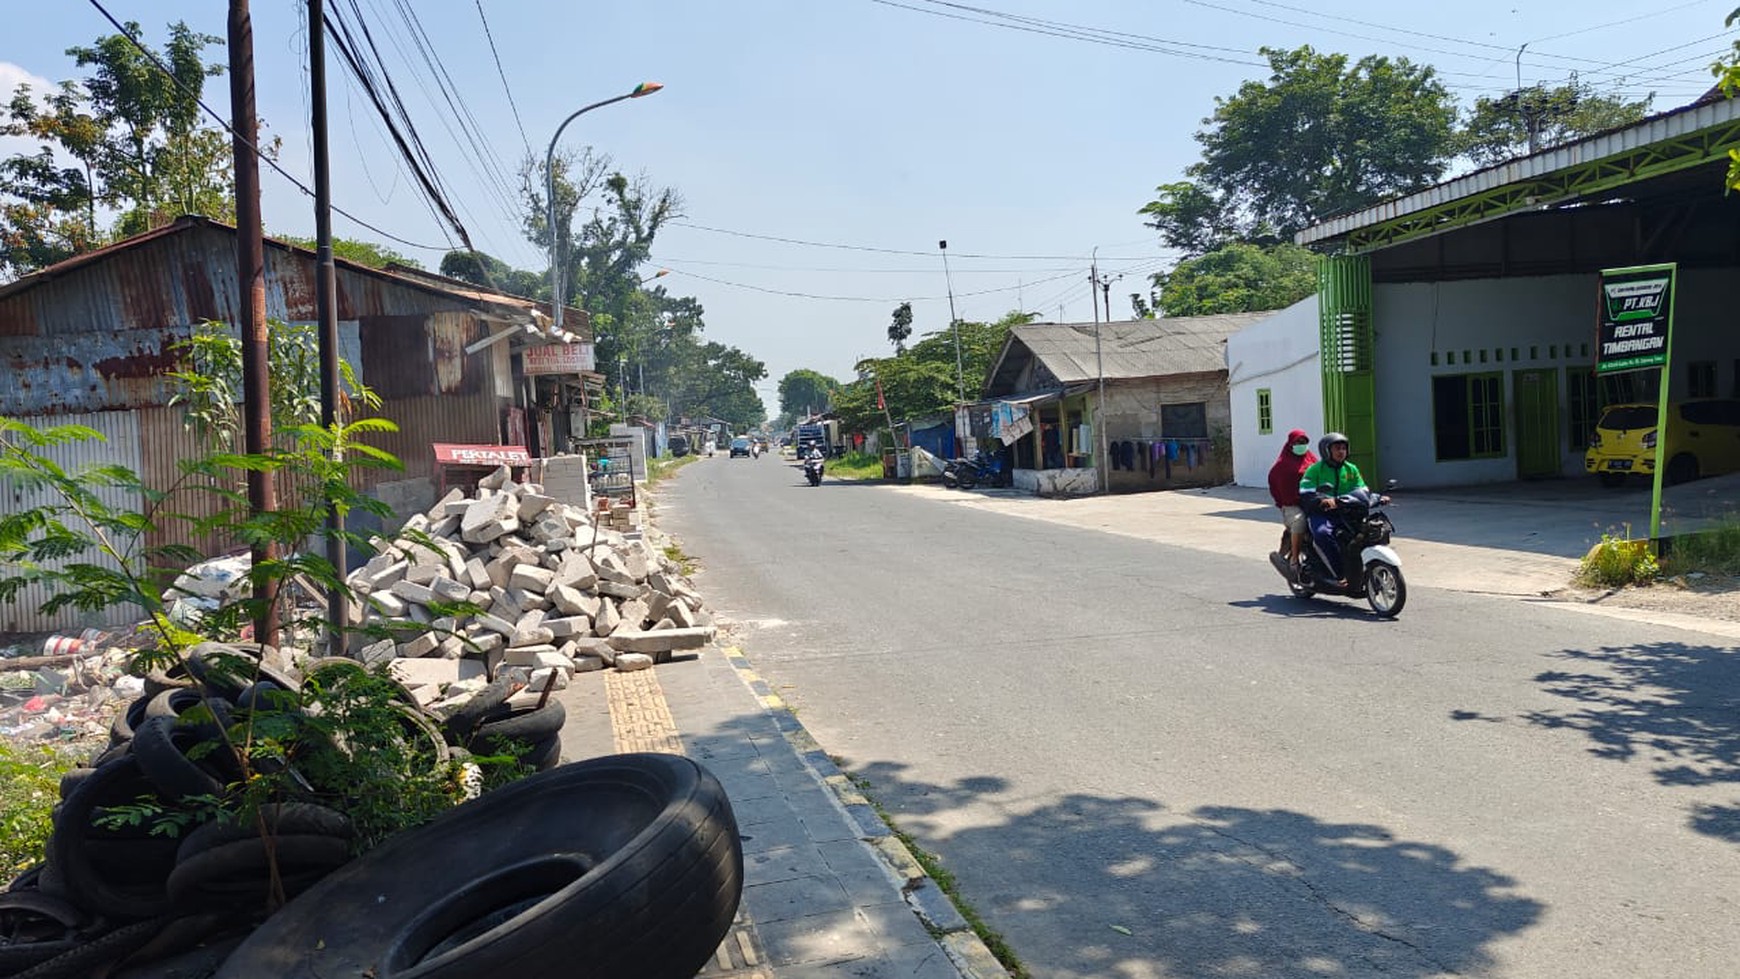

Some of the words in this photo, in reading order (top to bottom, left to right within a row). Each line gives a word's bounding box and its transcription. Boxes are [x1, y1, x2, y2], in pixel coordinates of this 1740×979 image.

[1623, 295, 1660, 310] PT.KBJ
[1614, 322, 1653, 338] RENTAL
[527, 345, 557, 358] JUAL
[563, 344, 589, 356] BELI
[1603, 336, 1664, 355] TIMBANGAN
